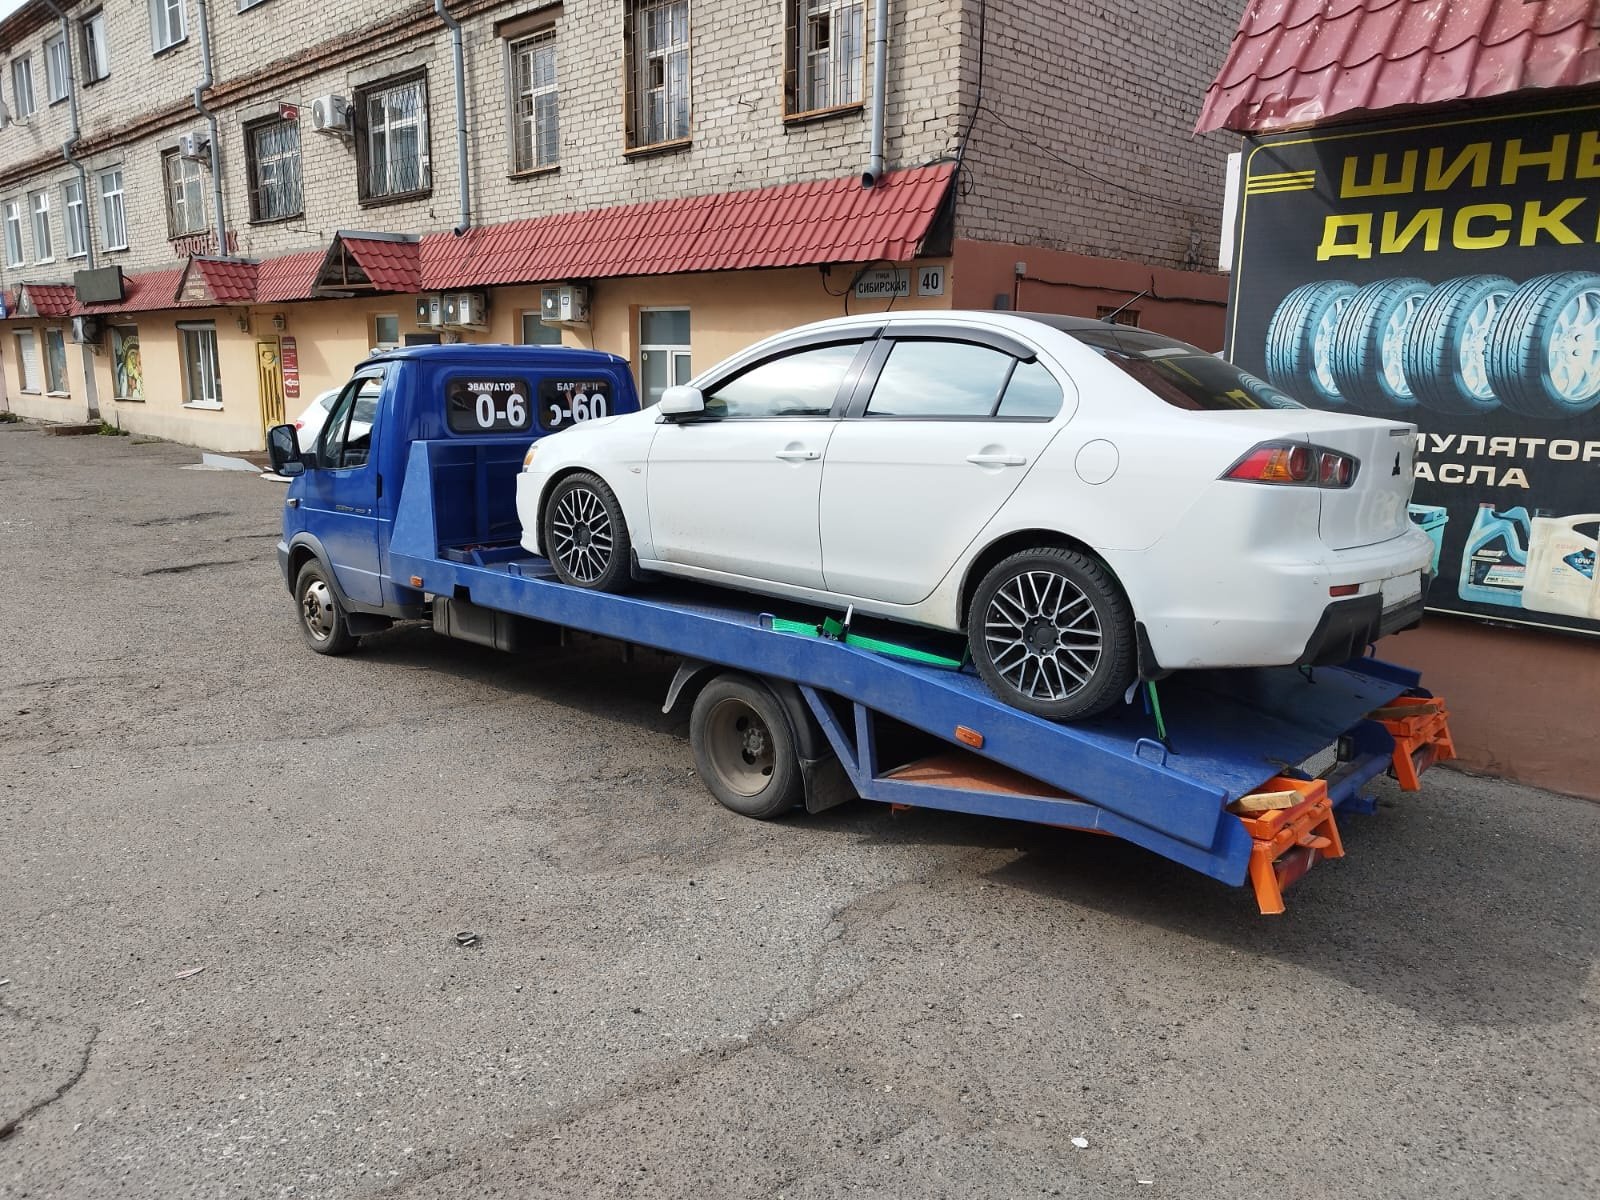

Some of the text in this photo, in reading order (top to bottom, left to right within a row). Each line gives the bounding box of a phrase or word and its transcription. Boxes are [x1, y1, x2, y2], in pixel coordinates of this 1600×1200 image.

[1316, 196, 1600, 261] ДИСК
[858, 272, 940, 293] СИБИРСКАЯ 40
[467, 382, 516, 391] ЭВАКУАТОР
[475, 393, 526, 428] 0-6
